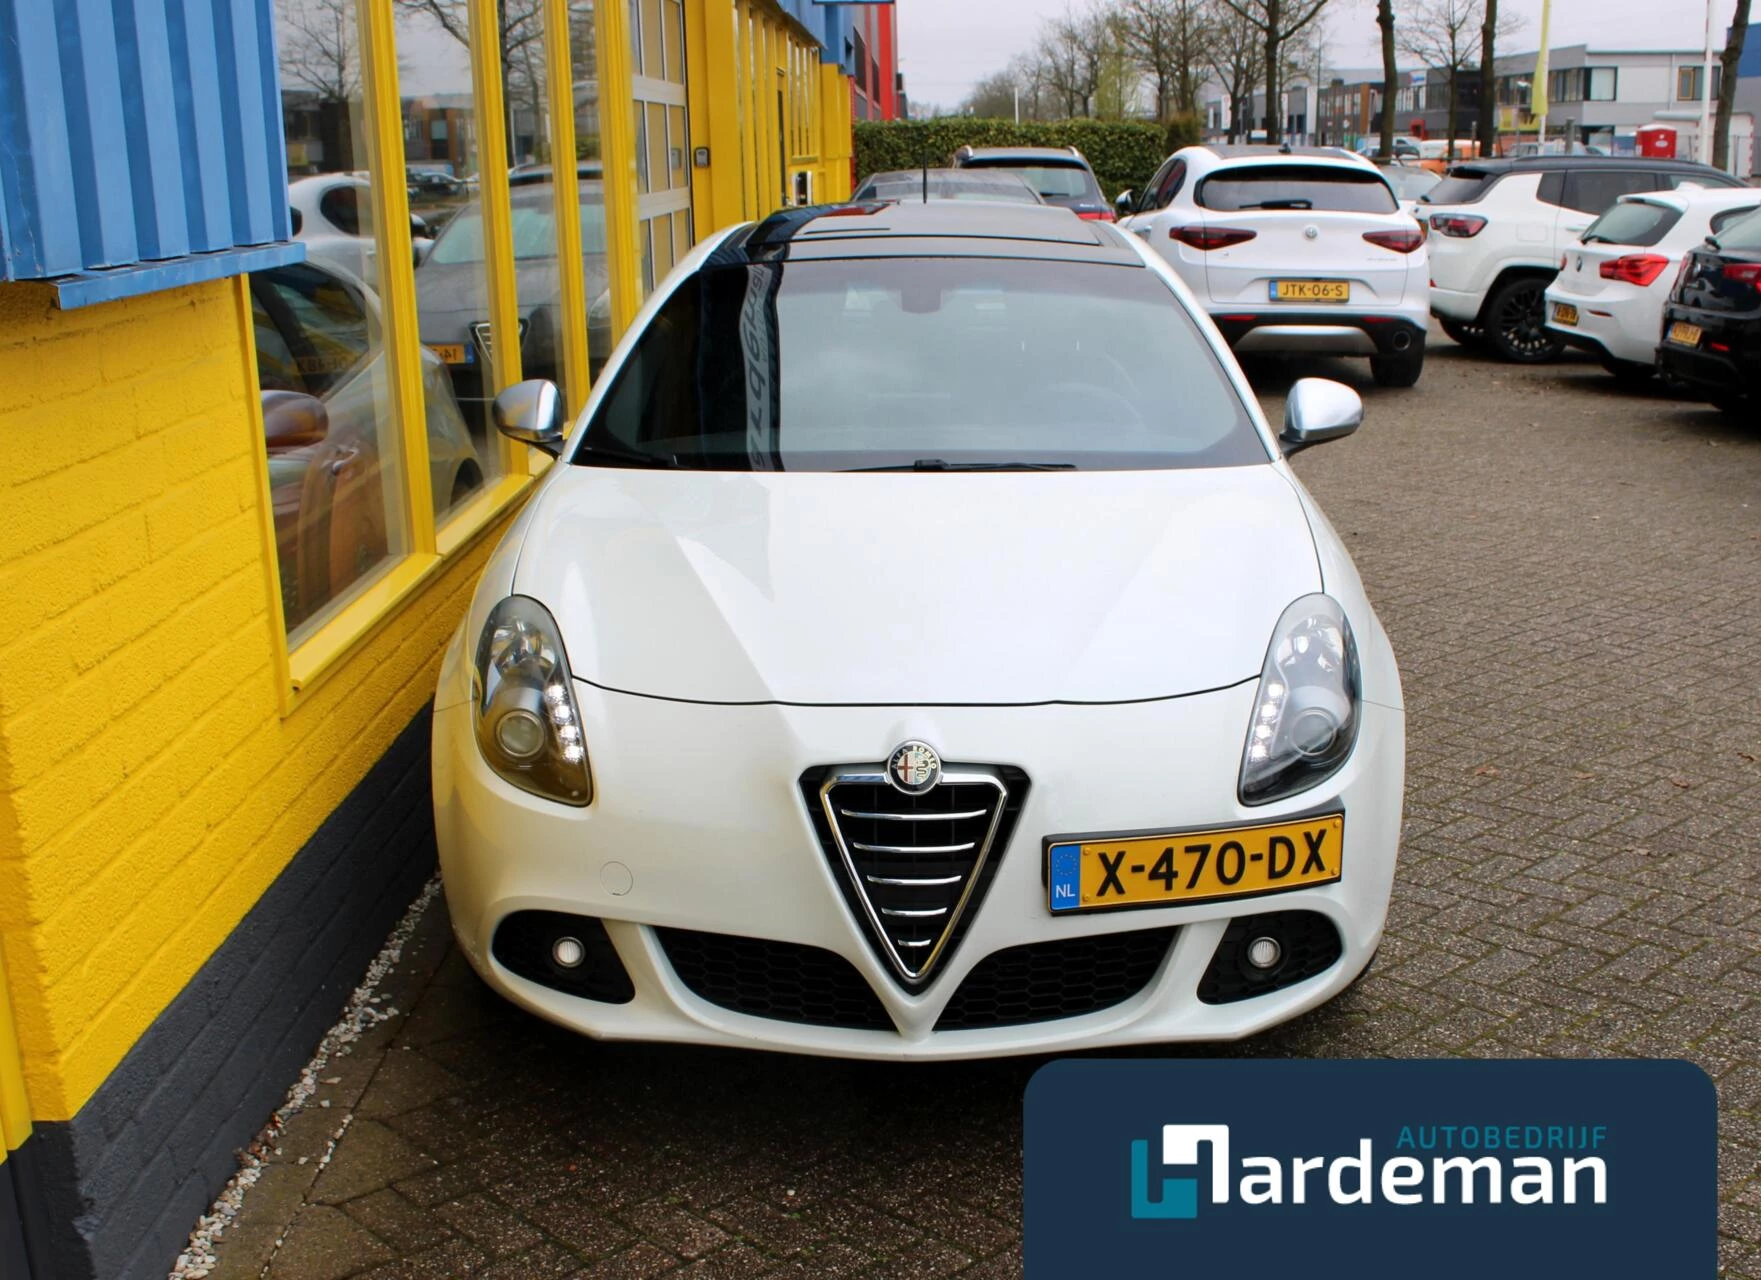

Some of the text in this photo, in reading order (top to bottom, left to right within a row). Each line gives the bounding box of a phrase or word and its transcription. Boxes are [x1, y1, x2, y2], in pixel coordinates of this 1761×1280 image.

[1282, 283, 1343, 297] JTK-06-S
[1096, 829, 1327, 897] X-470-DX
[1055, 884, 1075, 898] NL
